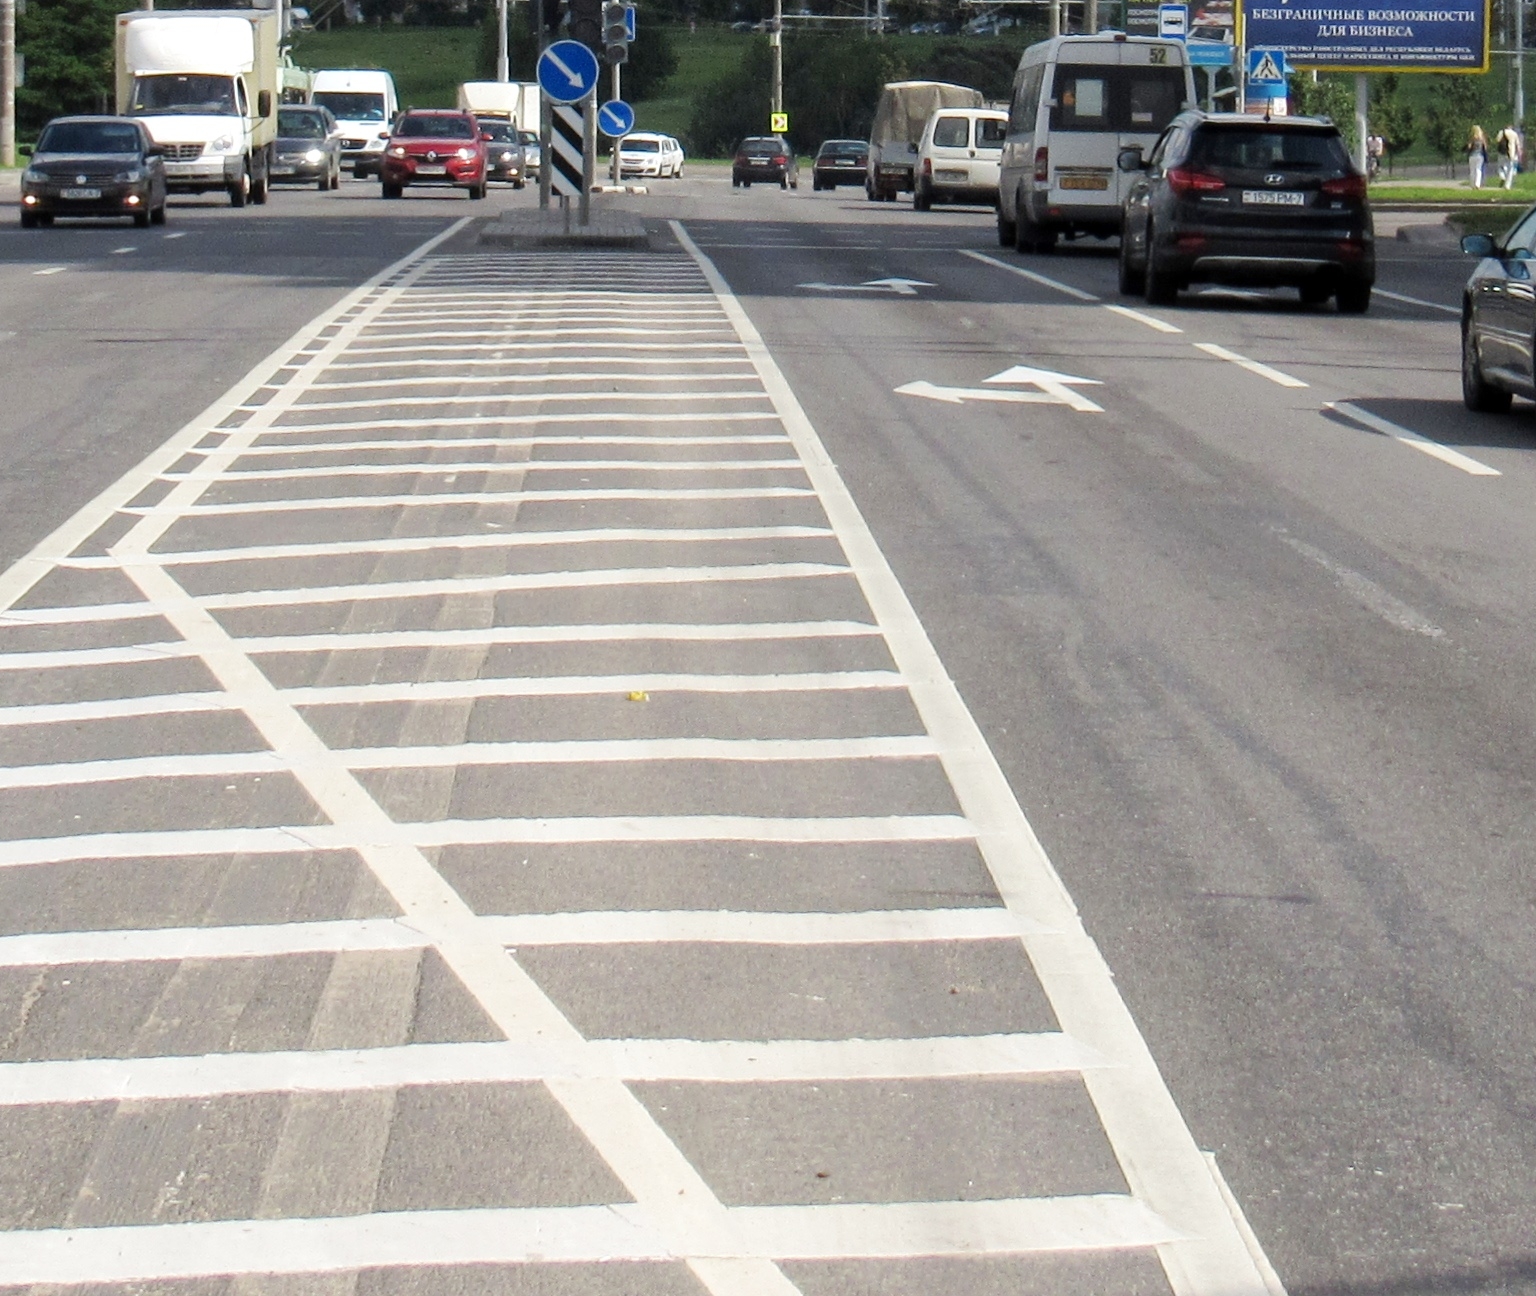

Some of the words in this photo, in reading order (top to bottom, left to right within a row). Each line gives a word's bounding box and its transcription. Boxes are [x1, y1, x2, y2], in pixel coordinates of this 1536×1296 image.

[1252, 8, 1364, 21] БЕЗГРАНИЧНЫЕ
[1368, 9, 1475, 22] ВОЗМОЖНОСТИ
[1317, 24, 1346, 38] ДЛЯ
[1350, 24, 1413, 37] БИЗНЕСА
[1150, 48, 1166, 64] 52
